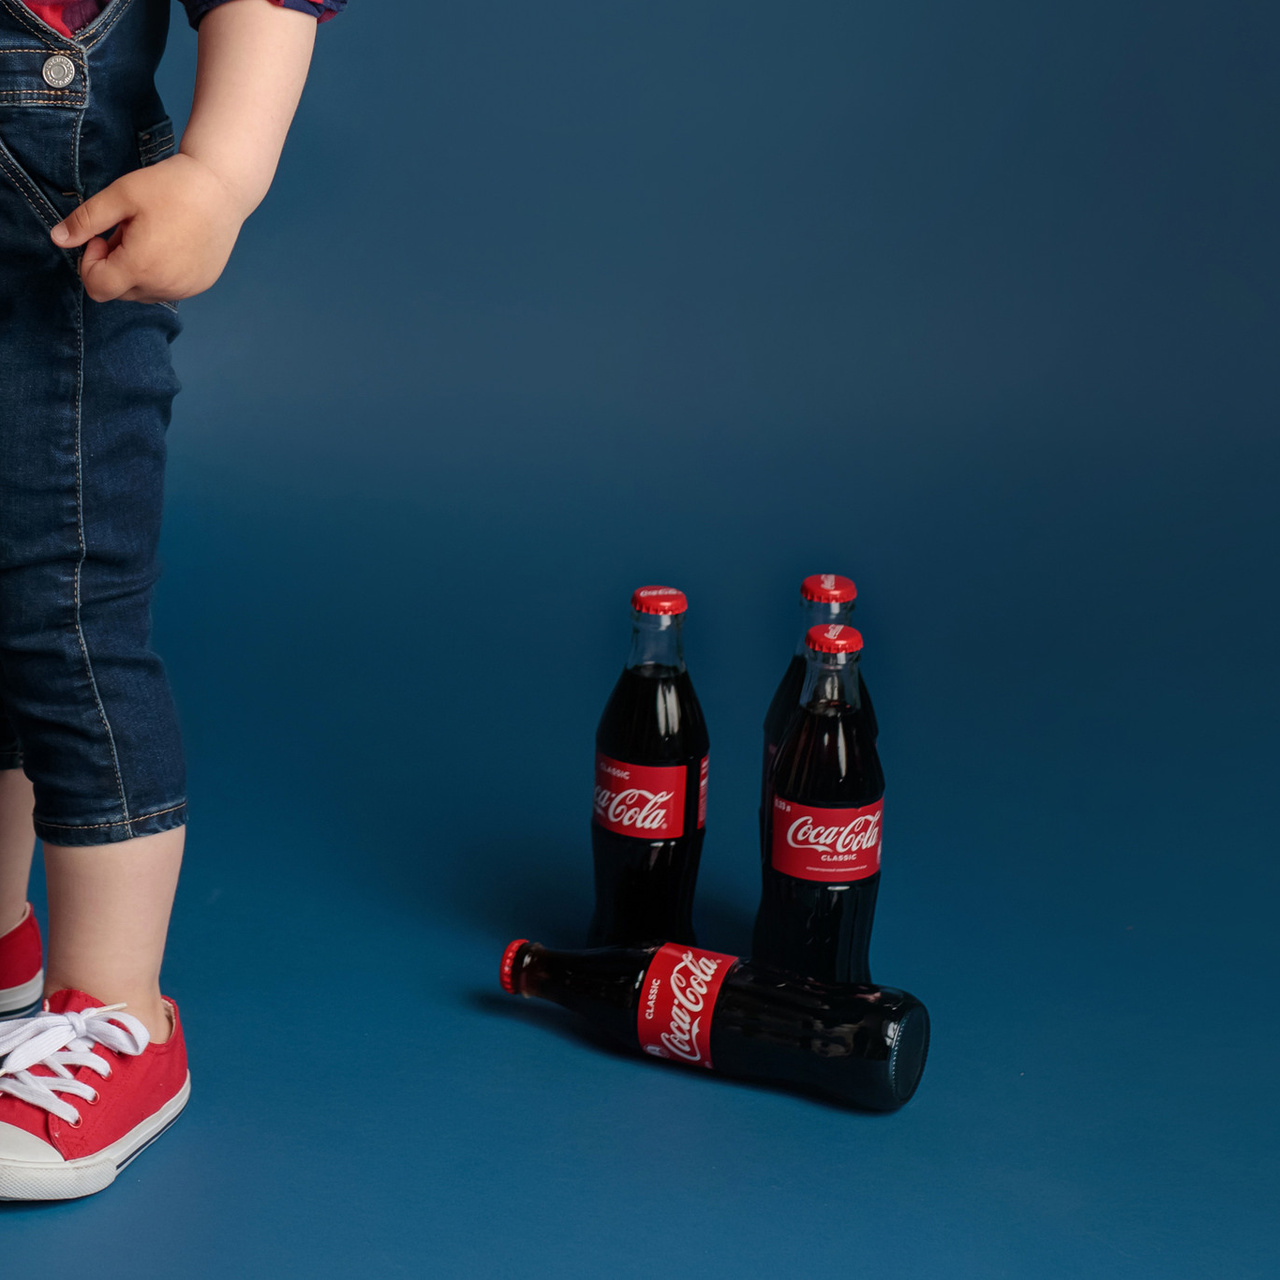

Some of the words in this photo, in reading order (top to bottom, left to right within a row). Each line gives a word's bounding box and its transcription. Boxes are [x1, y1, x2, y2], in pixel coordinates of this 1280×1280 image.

[820, 853, 857, 862] CLASSIC
[645, 978, 661, 1020] CLASSIC
[660, 950, 718, 1061] Coca-Cola
